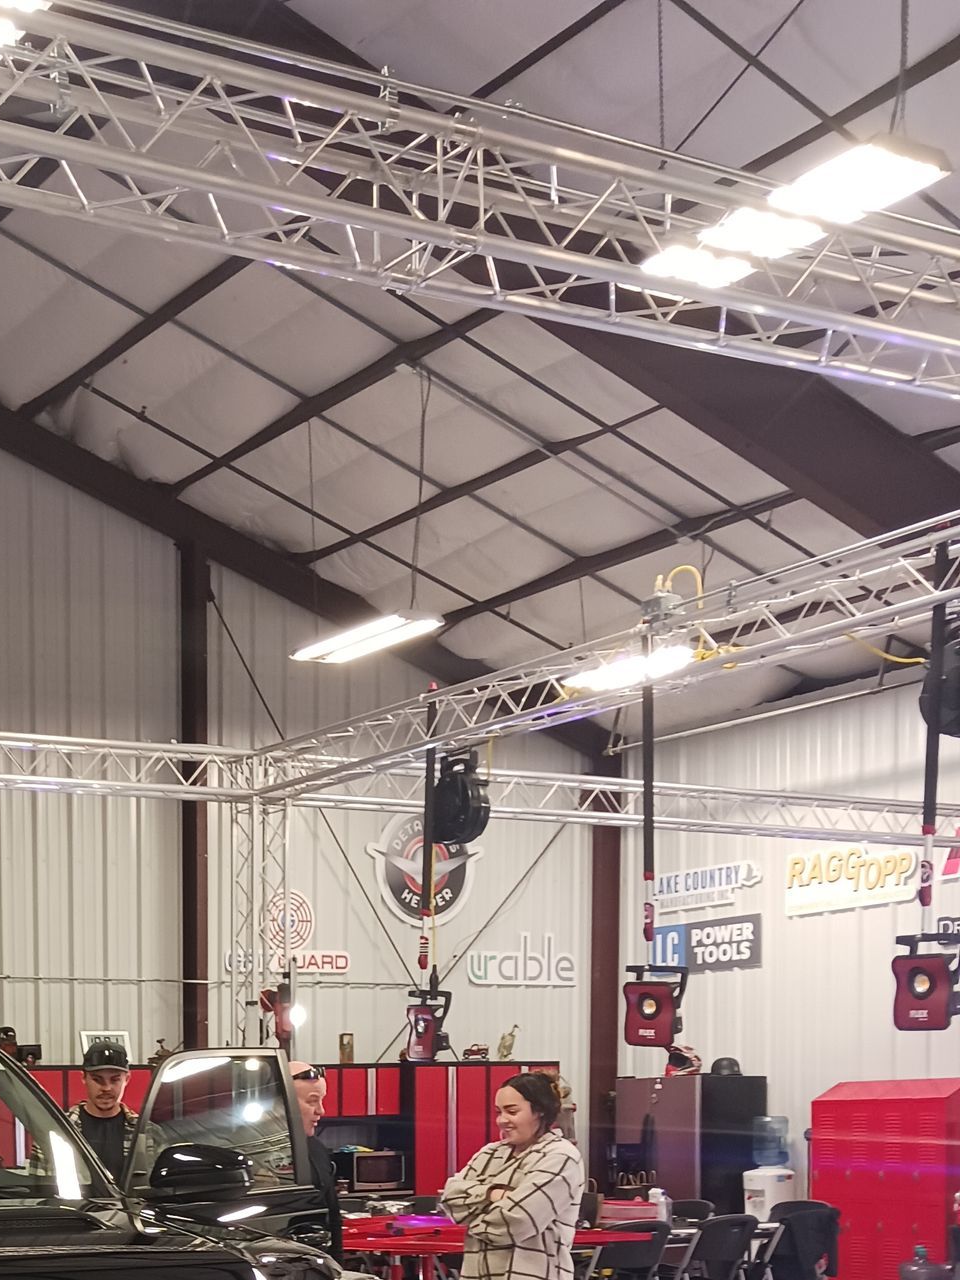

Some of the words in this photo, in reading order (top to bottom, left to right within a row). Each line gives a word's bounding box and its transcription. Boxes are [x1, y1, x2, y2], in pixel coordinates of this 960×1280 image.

[653, 874, 680, 897] AKE
[685, 864, 742, 892] COUNTRY
[655, 931, 679, 967] LC
[691, 922, 754, 947] POWER
[470, 935, 575, 982] urable
[693, 941, 752, 965] TOOLS
